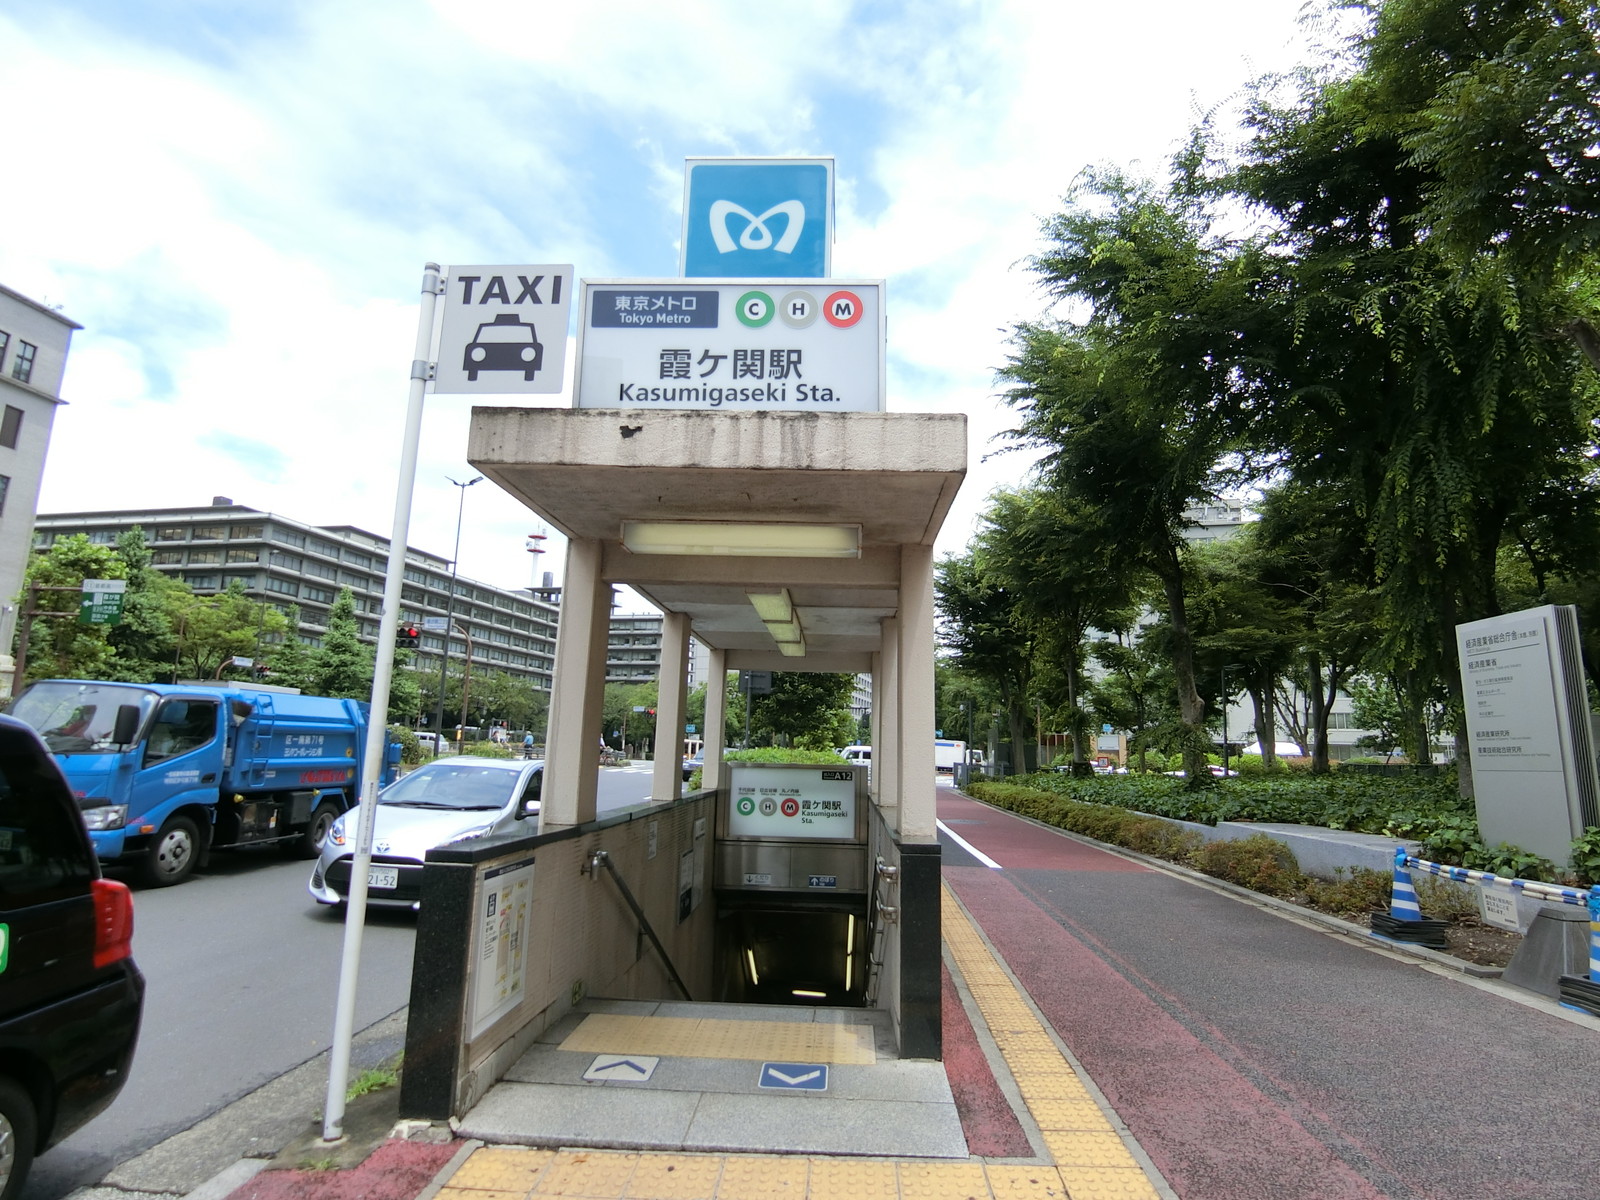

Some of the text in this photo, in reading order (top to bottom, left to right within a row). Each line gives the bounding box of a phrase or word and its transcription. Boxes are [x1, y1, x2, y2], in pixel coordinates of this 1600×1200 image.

[458, 275, 563, 305] TAXI
[614, 295, 697, 311] 東京メトロ
[748, 303, 852, 316] C H M
[619, 312, 692, 326] Tokyo Metro
[659, 348, 803, 380] 霞ケ関駅
[618, 382, 841, 407] Kasumigaseki Sta.
[834, 772, 852, 780] A12
[802, 800, 842, 810] 霞ケ関駅
[801, 810, 848, 819] Kasumigaseki
